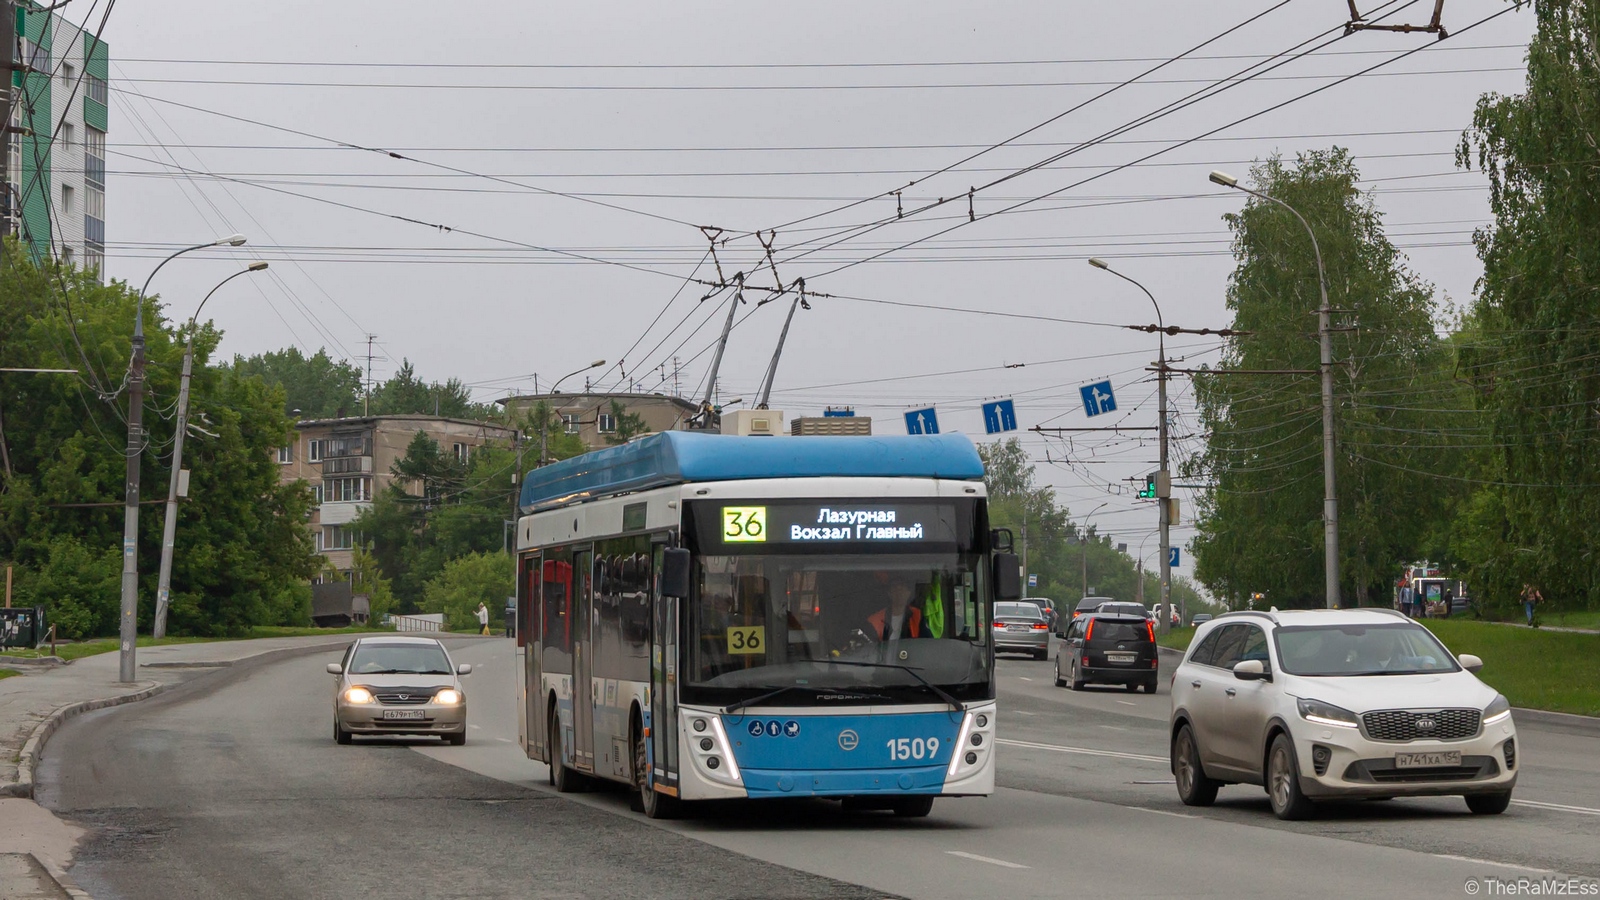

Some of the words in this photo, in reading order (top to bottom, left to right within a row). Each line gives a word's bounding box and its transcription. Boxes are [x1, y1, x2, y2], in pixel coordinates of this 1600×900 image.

[725, 511, 763, 537] 36
[817, 508, 896, 524] Лазурная
[791, 525, 851, 540] Вокзал
[856, 522, 923, 540] Главный
[732, 630, 760, 649] 36
[886, 737, 940, 761] 1509
